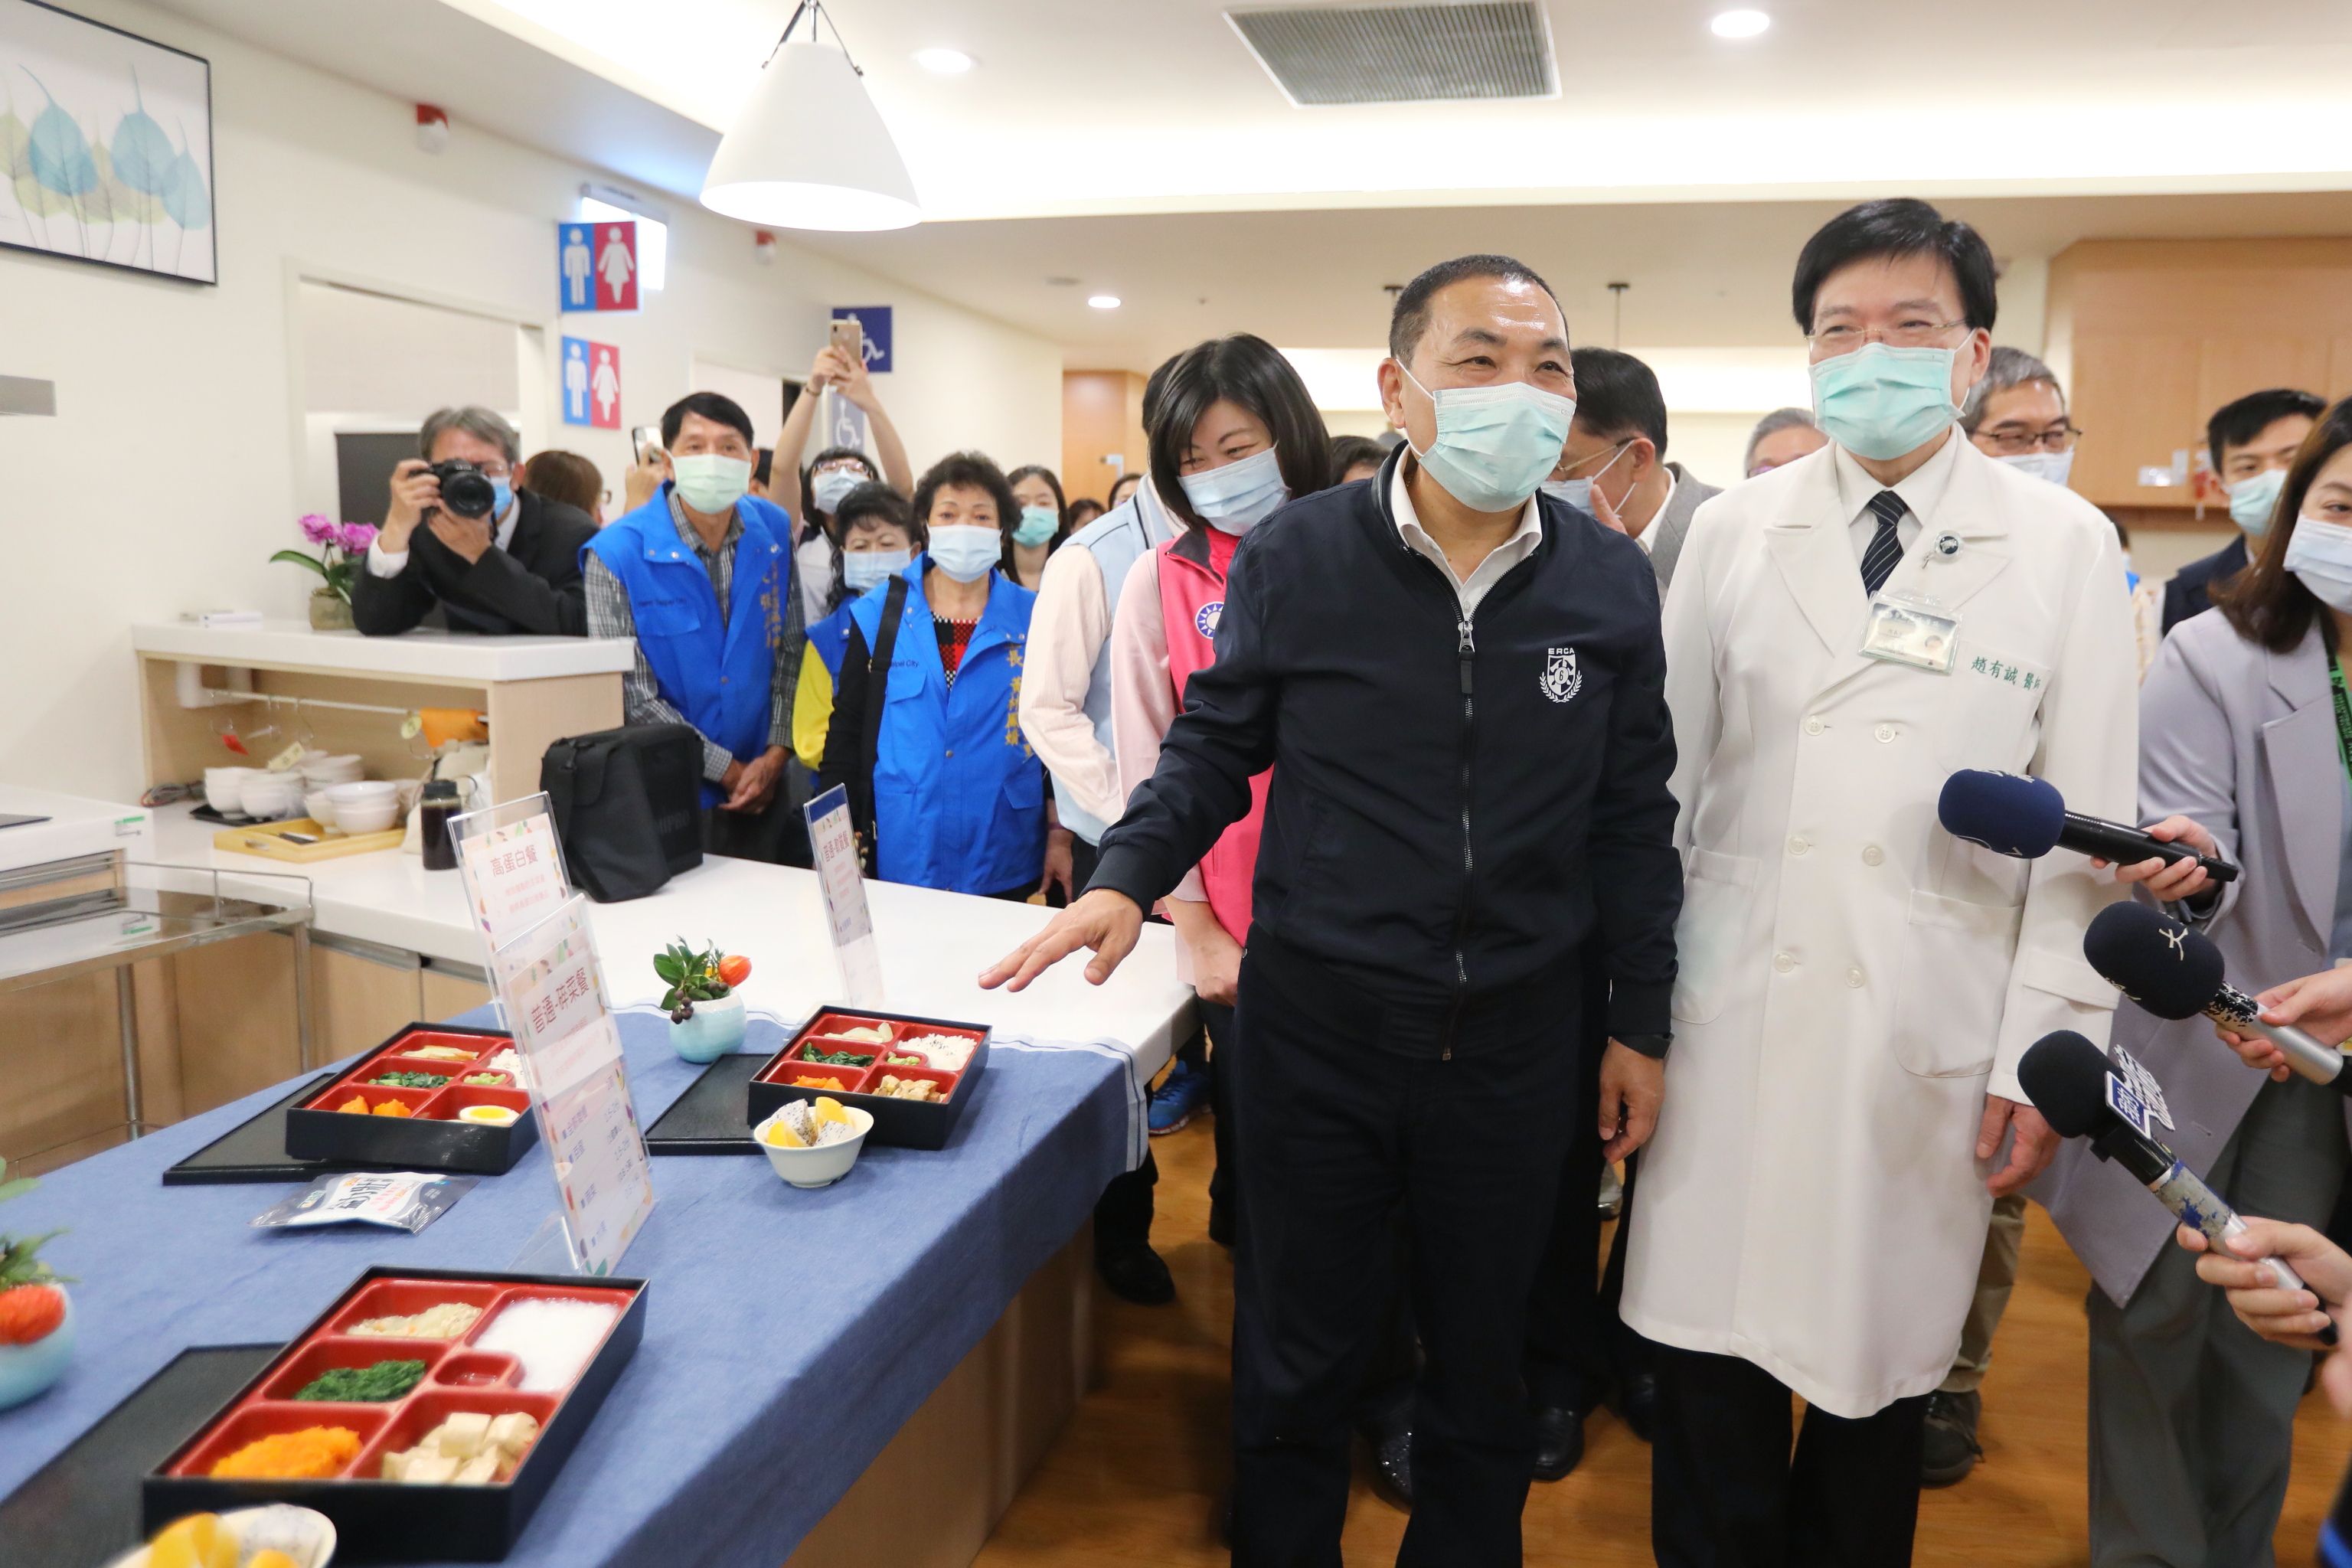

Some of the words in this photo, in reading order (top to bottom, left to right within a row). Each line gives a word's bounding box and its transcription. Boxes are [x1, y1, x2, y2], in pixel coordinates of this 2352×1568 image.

[1559, 669, 1564, 681] 6
[1971, 655, 2019, 686] 趙有誠
[490, 844, 538, 877] 高蛋白餐
[531, 966, 590, 1034] 普通-碎菜餐
